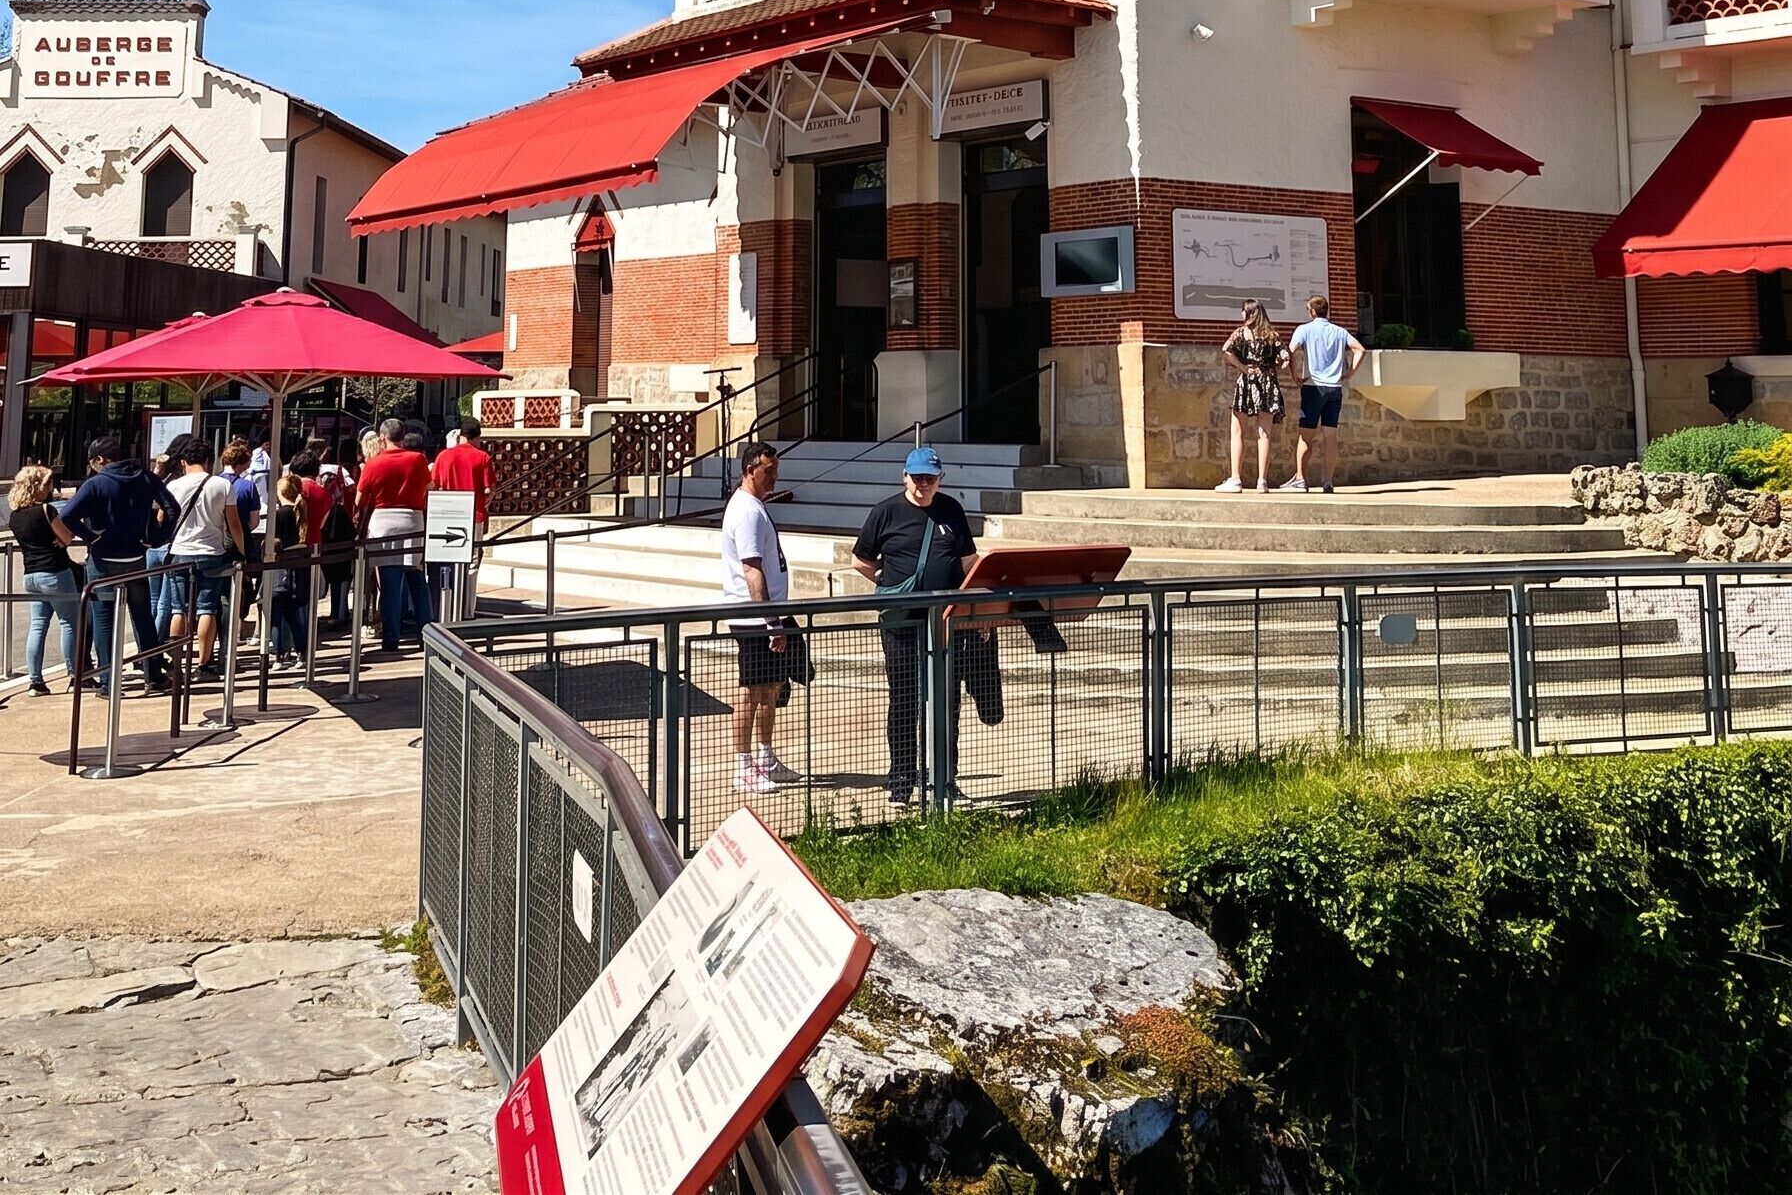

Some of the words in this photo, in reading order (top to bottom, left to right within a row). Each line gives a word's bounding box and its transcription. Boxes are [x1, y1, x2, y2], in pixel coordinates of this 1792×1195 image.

[34, 37, 173, 53] AUBERGE
[91, 56, 116, 66] DE
[34, 70, 171, 87] GOUFFRE
